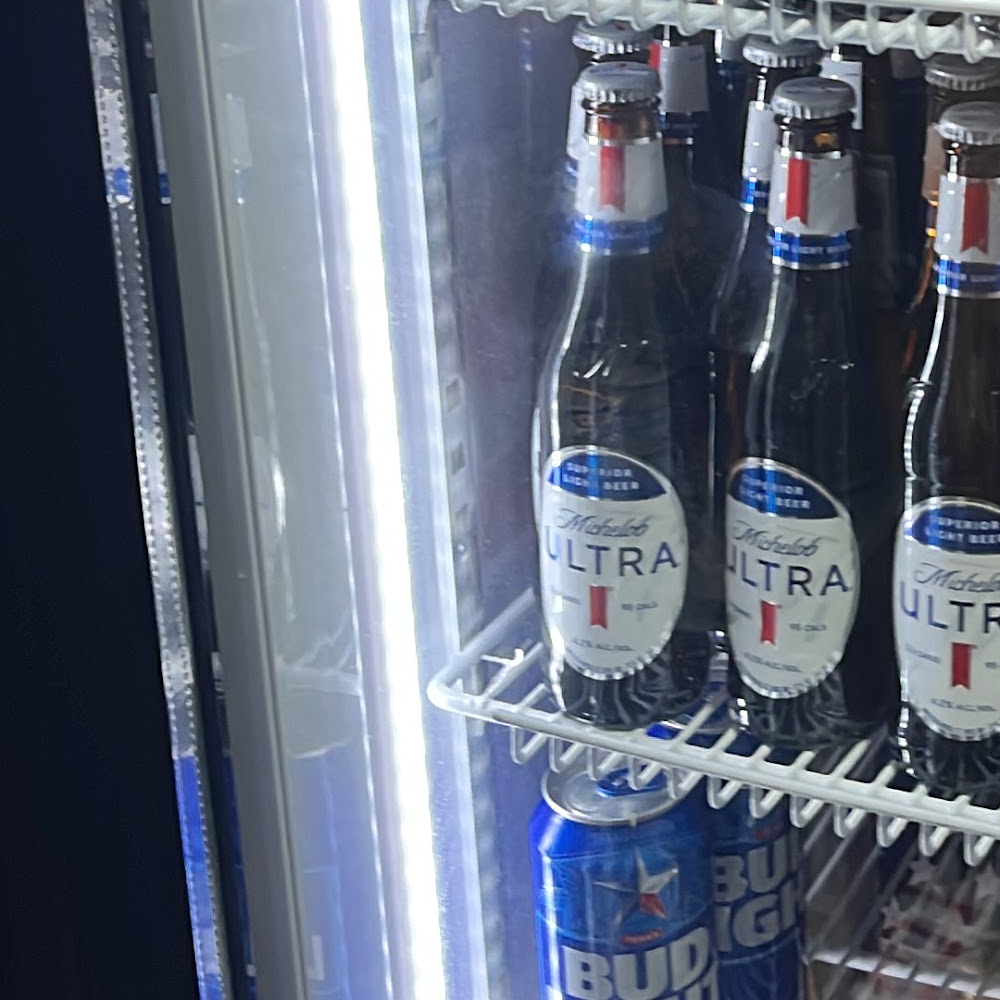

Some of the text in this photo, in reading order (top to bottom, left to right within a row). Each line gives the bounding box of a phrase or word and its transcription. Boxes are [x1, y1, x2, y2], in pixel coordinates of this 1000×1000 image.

[545, 525, 679, 577] ULTRA
[711, 833, 798, 902] BU
[561, 926, 709, 1000] BUD
